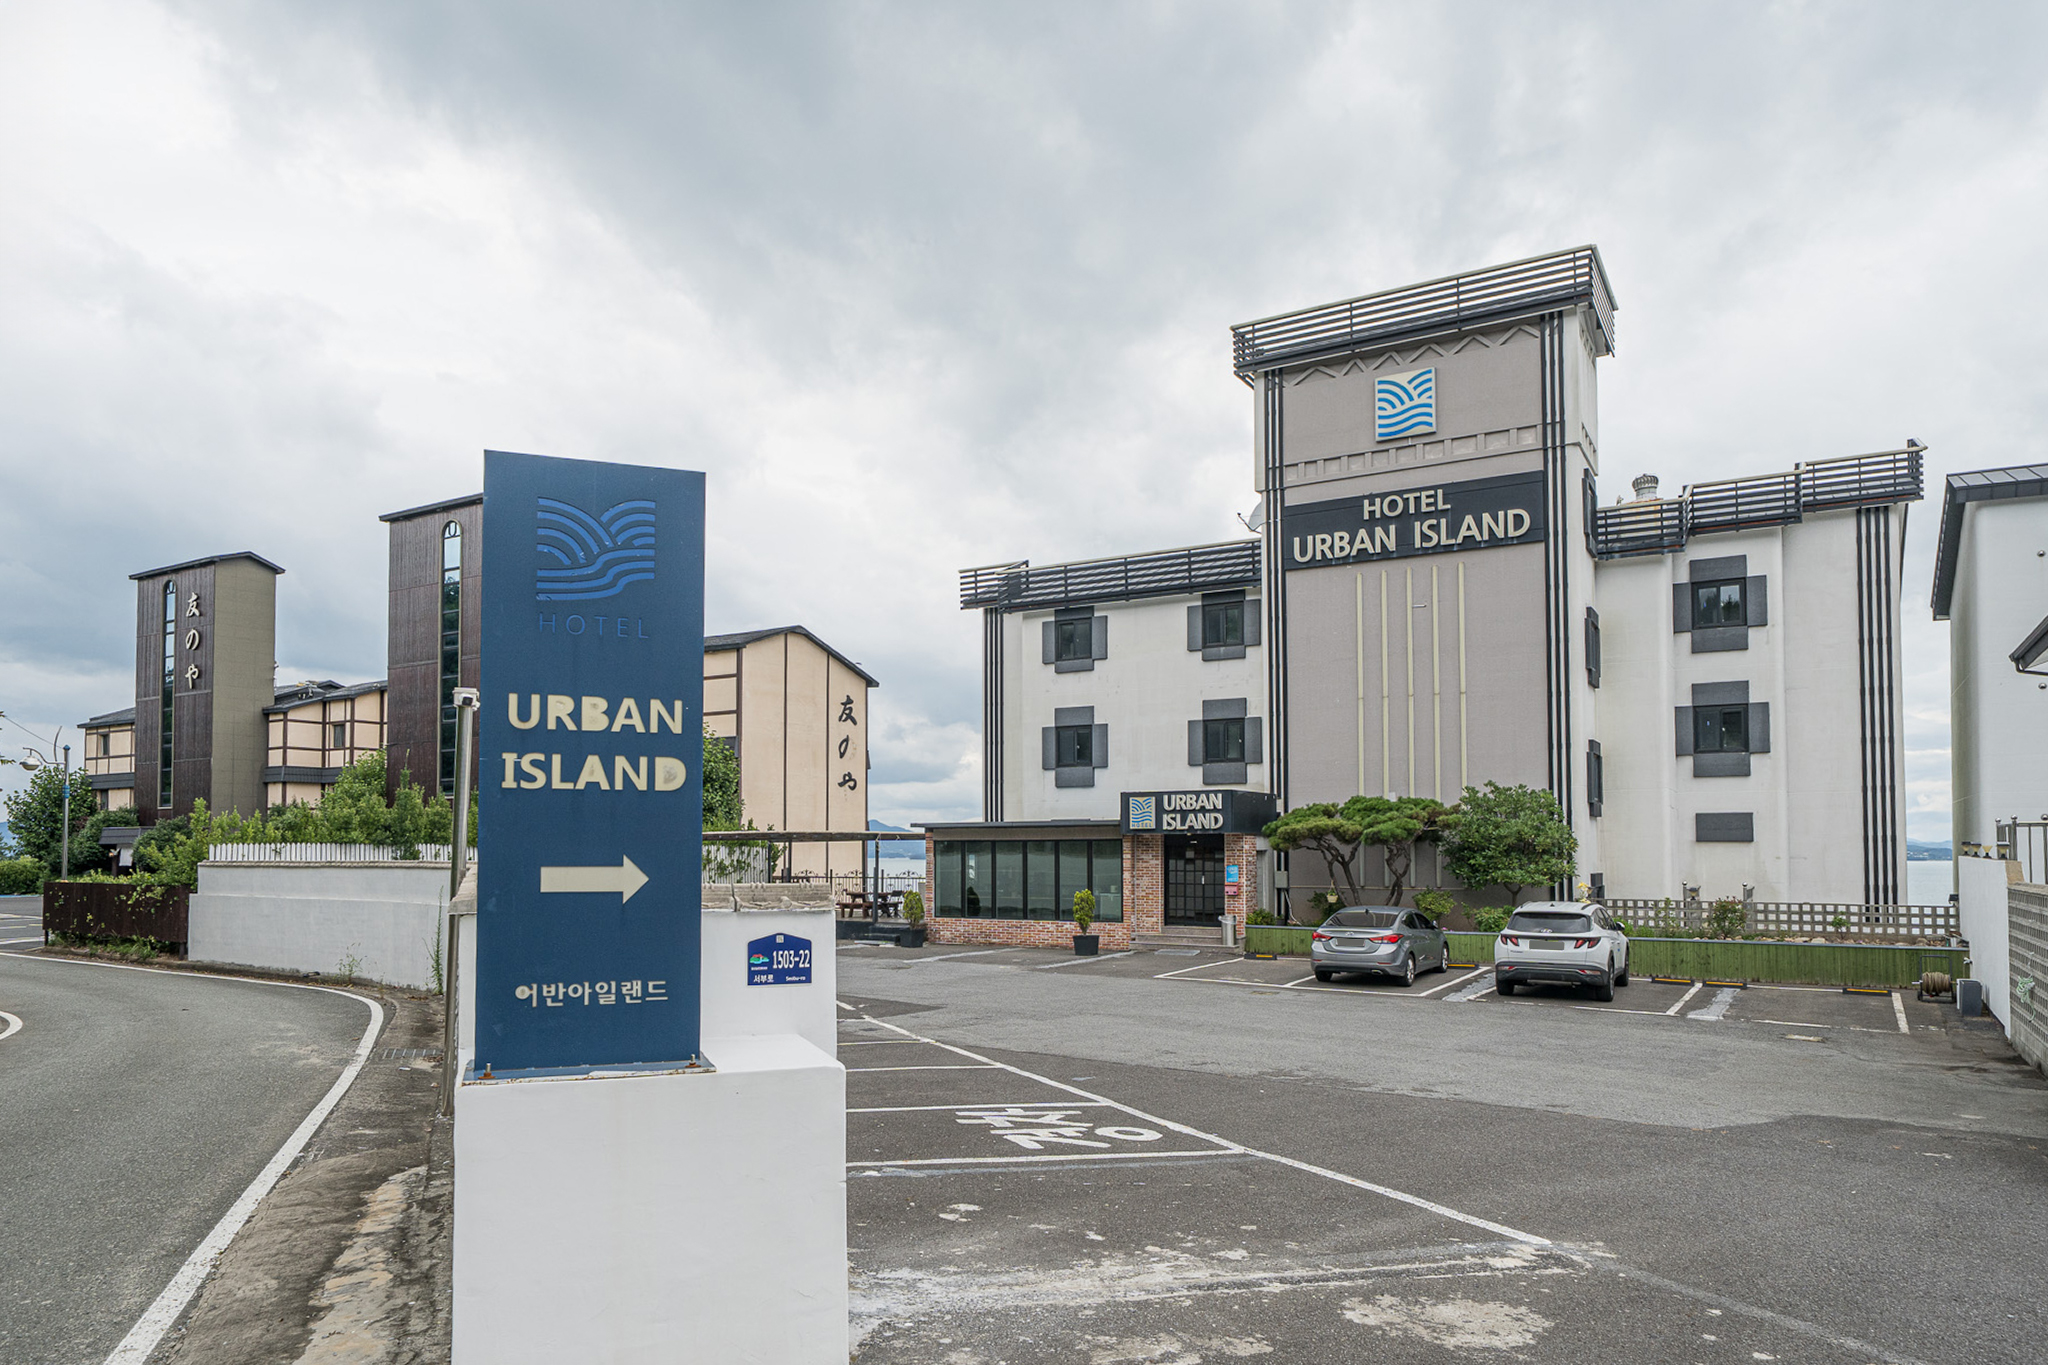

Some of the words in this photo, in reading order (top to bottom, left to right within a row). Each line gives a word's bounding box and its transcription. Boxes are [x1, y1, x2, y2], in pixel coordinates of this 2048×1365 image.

[1362, 488, 1451, 521] HOTEL
[1293, 524, 1396, 563] URBAN
[1414, 508, 1531, 549] ISLAND
[184, 592, 200, 690] 友のや
[538, 612, 649, 639] HOTEL
[507, 692, 683, 735] URBAN
[501, 752, 687, 792] ISLAND
[1162, 793, 1223, 811] URBAN
[1162, 812, 1224, 831] ISLAND
[772, 949, 810, 969] 1503-22
[515, 979, 669, 1008] 어반아일랜드
[955, 1107, 1164, 1150] 경차
